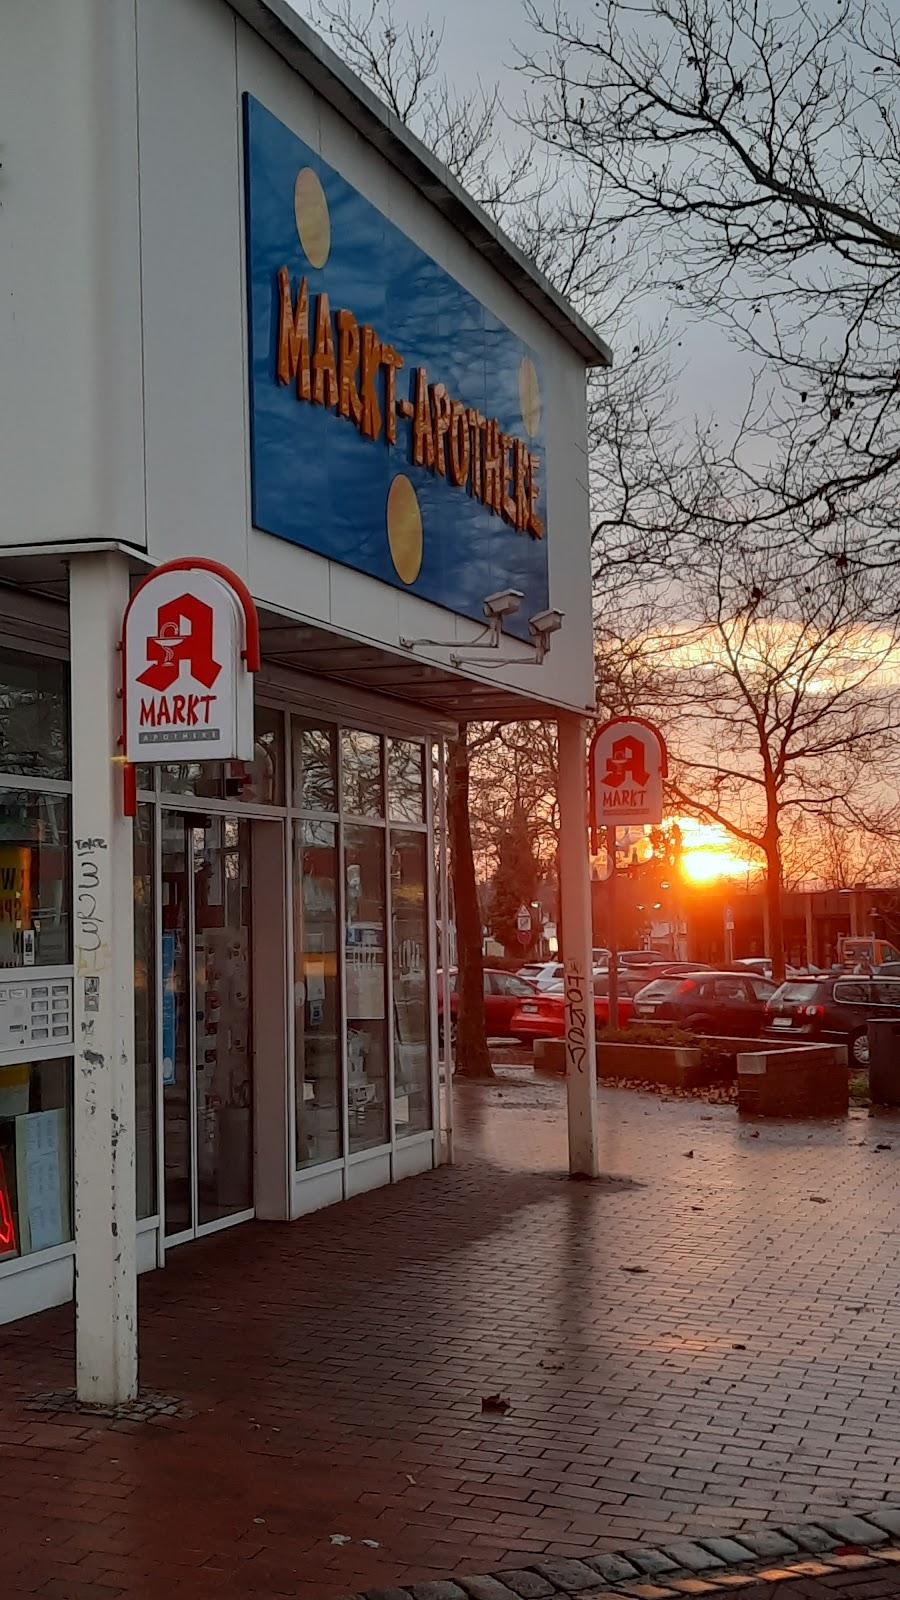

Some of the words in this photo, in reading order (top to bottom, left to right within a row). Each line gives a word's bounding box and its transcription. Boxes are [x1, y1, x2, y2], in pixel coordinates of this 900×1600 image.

[139, 694, 217, 728] MARKT
[141, 731, 217, 742] APOTHEKE
[603, 790, 647, 807] MARKT
